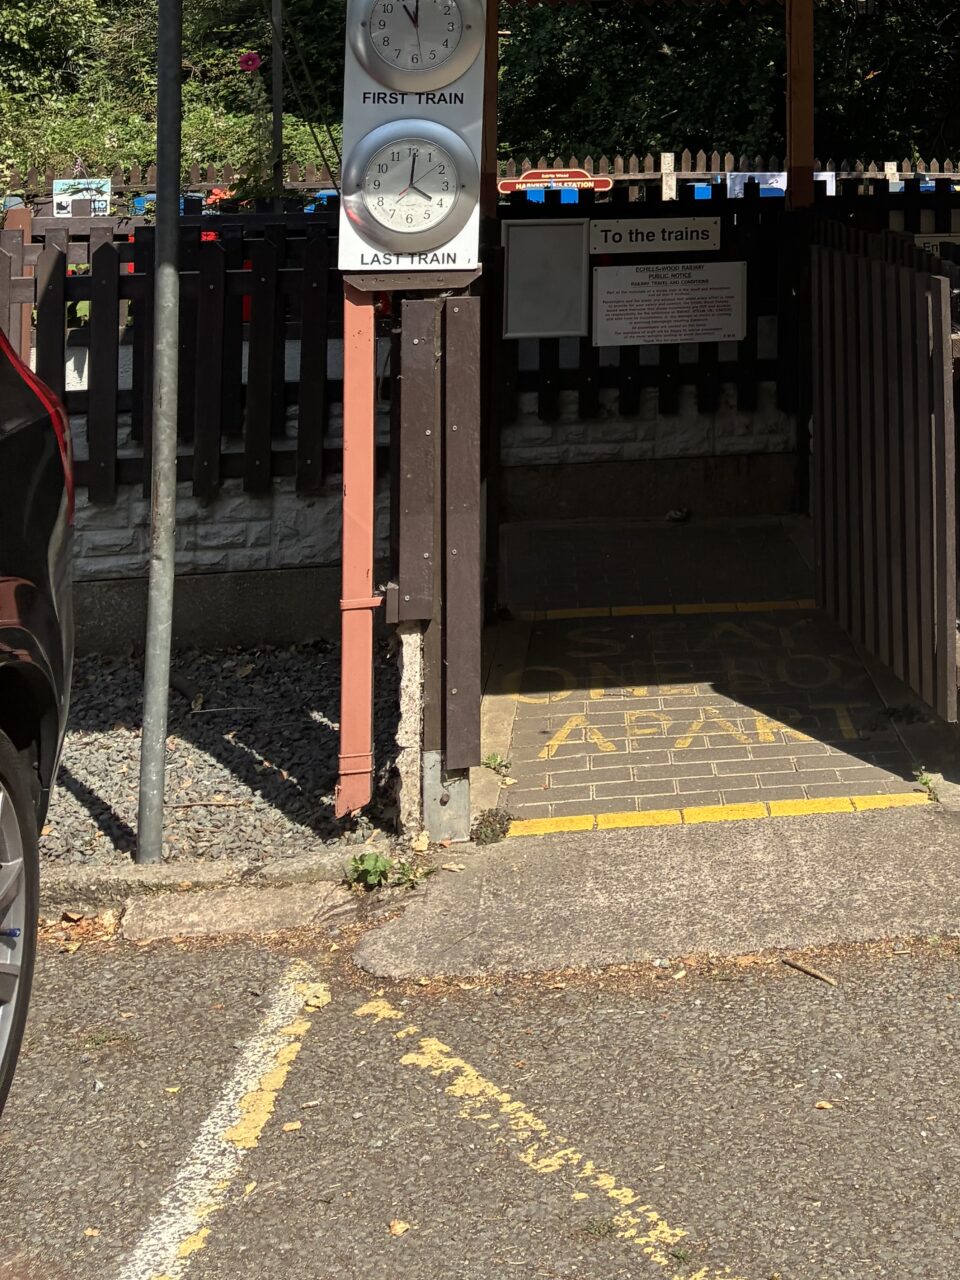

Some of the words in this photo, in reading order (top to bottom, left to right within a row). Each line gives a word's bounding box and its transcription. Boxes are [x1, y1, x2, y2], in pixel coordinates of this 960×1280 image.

[382, 3, 393, 13] 10
[443, 6, 451, 15] 2
[378, 20, 385, 30] 9
[447, 22, 455, 32] 3
[382, 36, 389, 46] 8
[442, 39, 449, 48] 4
[394, 49, 401, 59] 7
[411, 54, 419, 63] 6
[428, 50, 436, 60] 5
[362, 92, 408, 104] FIRST
[415, 92, 464, 104] TRAIN
[391, 152, 400, 161] 11
[408, 147, 419, 158] 12
[427, 153, 432, 162] 1
[377, 163, 388, 174] 10
[438, 165, 445, 175] 2
[373, 180, 380, 190] 9
[441, 181, 449, 191] 3
[563, 181, 594, 189] STATION
[377, 197, 384, 206] 8
[437, 198, 443, 208] 4
[389, 209, 396, 219] 7
[406, 214, 413, 224] 6
[423, 210, 431, 220] 5
[600, 229, 622, 243] To
[628, 228, 655, 242] the
[661, 227, 710, 241] trains
[361, 253, 402, 265] LAST
[408, 253, 457, 265] TRAIN
[538, 701, 872, 758] APART
